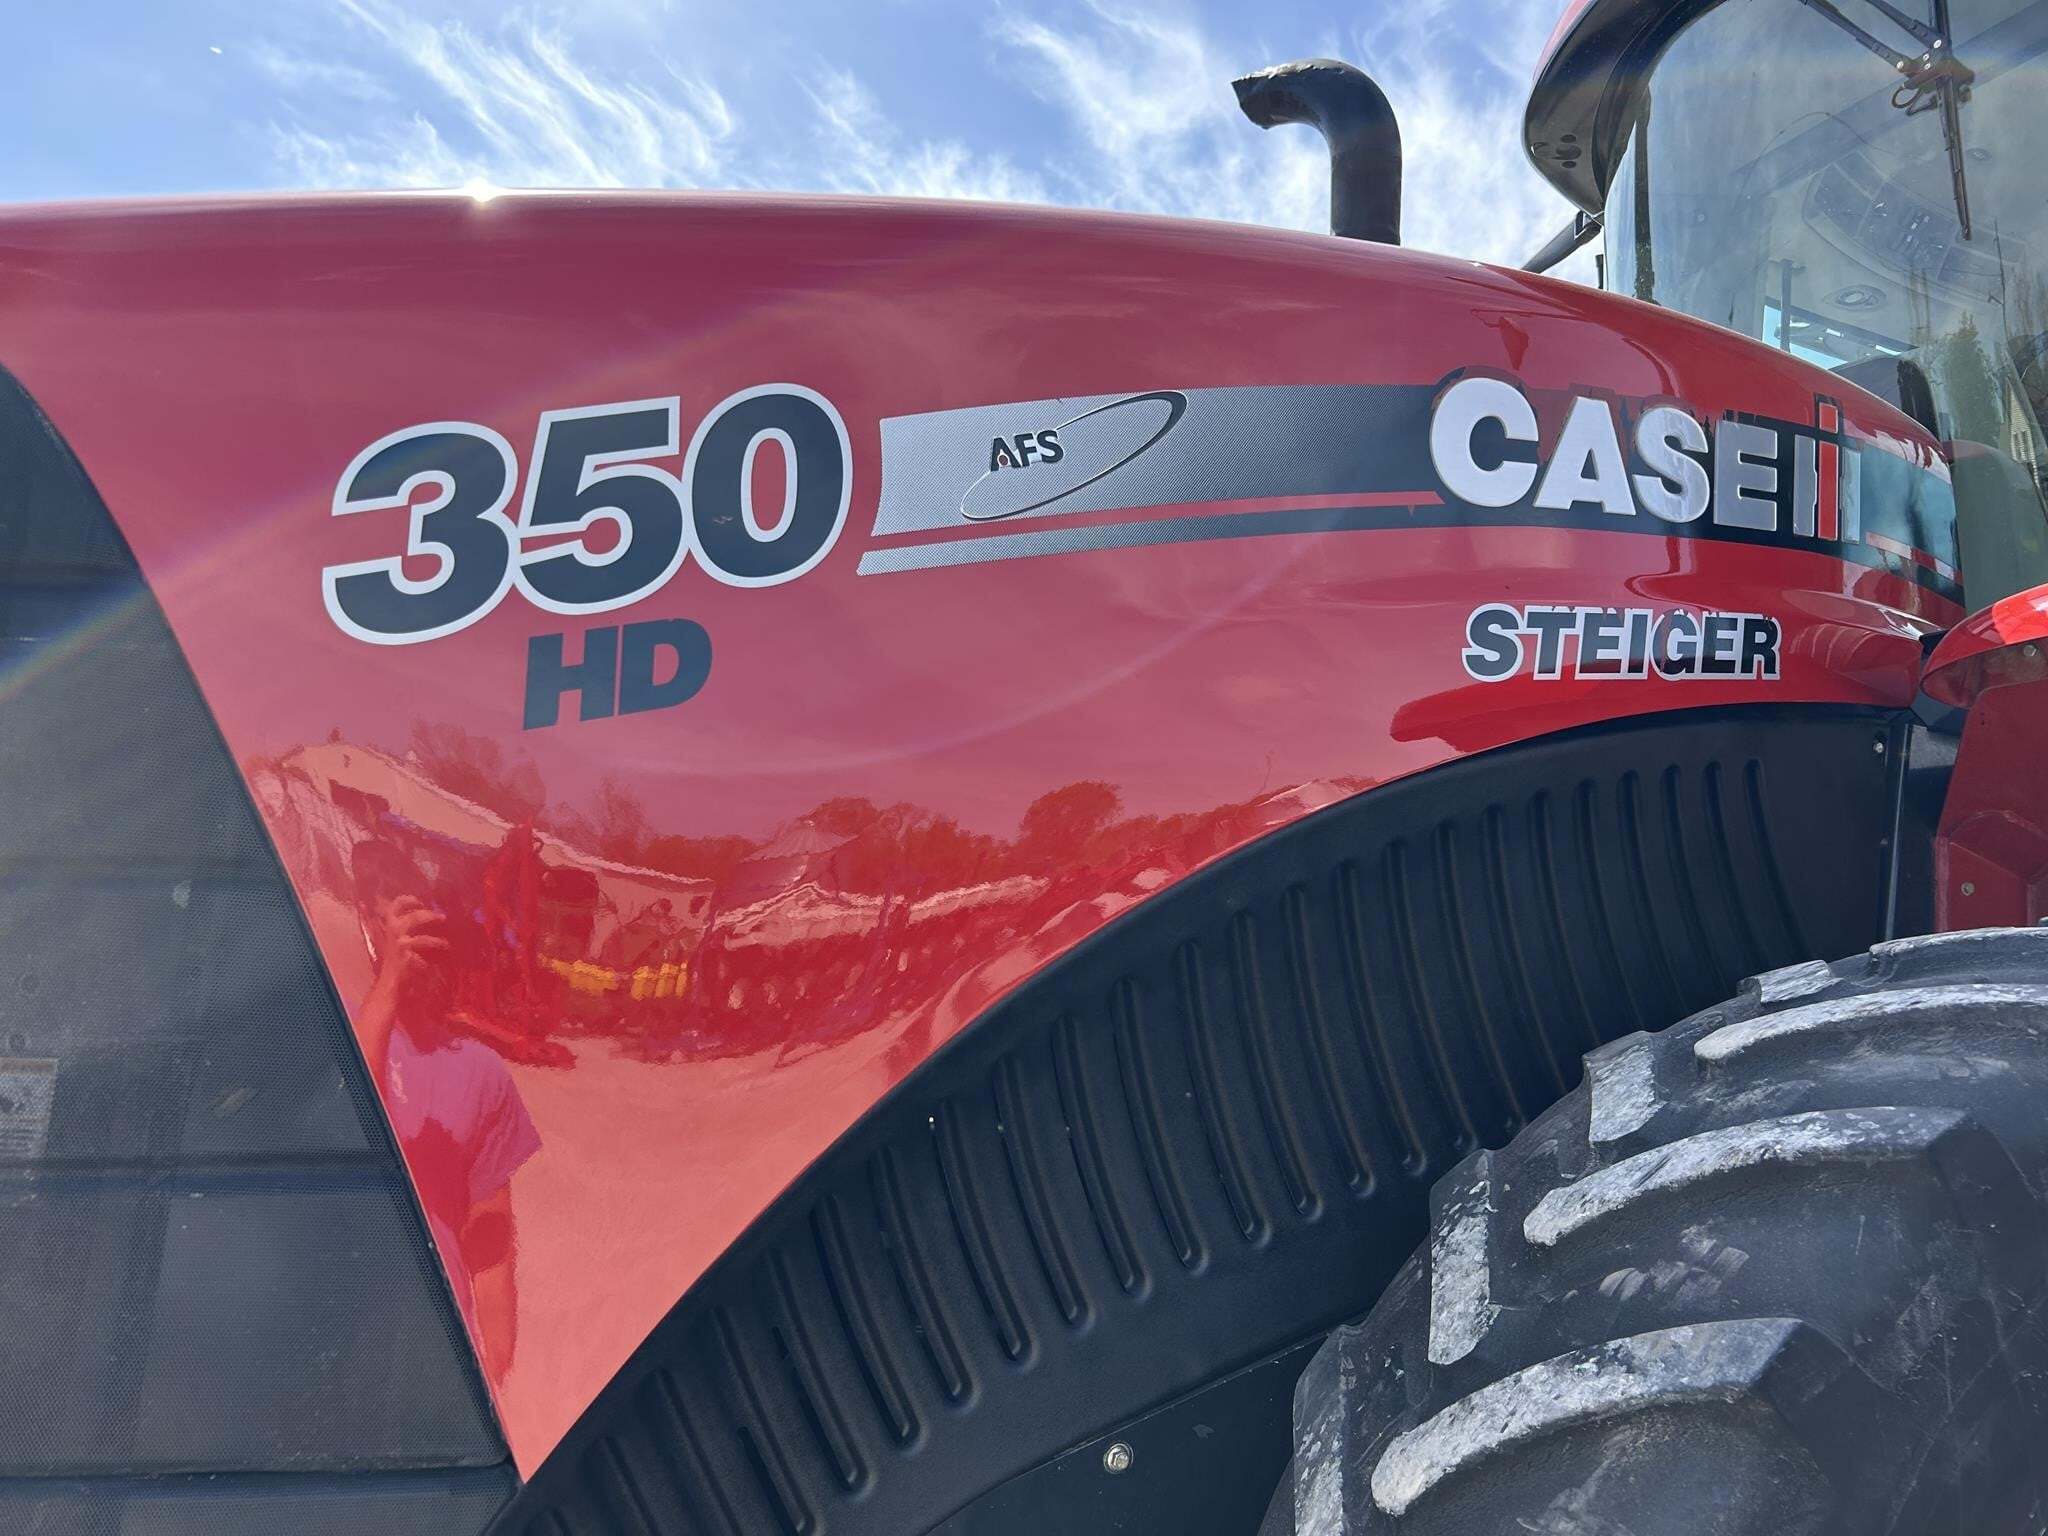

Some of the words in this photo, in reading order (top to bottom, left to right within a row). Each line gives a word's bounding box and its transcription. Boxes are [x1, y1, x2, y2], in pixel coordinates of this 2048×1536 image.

[990, 429, 1064, 472] AFS
[322, 383, 853, 645] 350
[522, 618, 713, 730] HD
[1461, 603, 1782, 683] STEIGER
